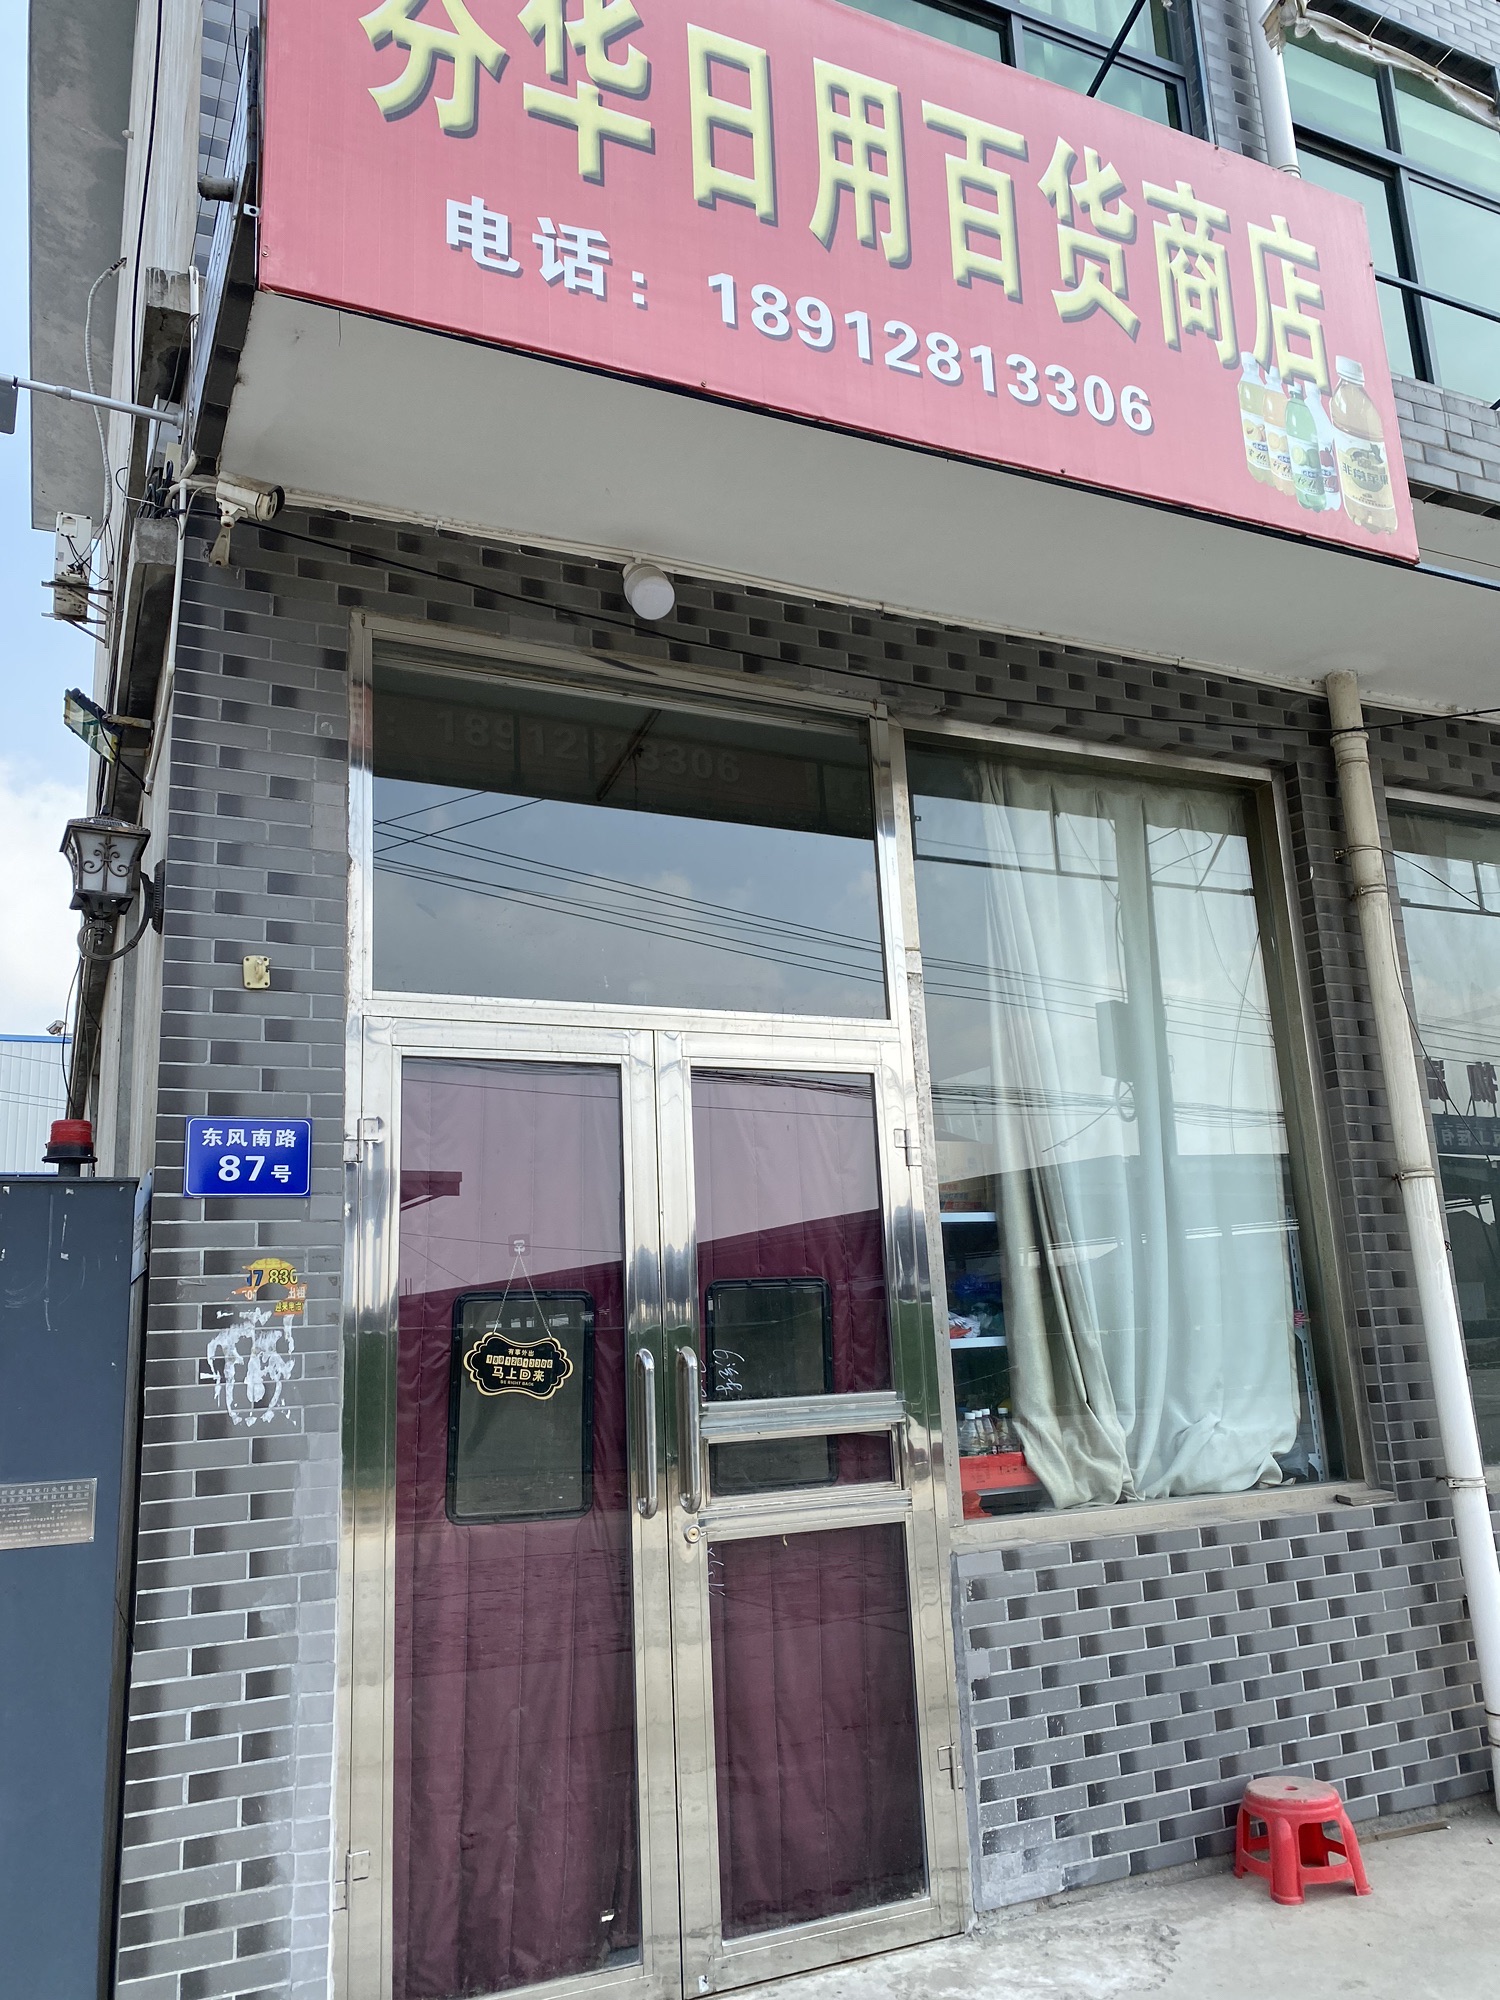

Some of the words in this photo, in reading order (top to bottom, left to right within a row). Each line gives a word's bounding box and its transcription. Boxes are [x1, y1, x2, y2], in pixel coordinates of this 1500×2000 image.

[445, 195, 649, 308] 电话：
[706, 272, 1155, 434] 18912813306
[202, 1127, 296, 1148] 东风南路
[218, 1155, 292, 1183] 87号
